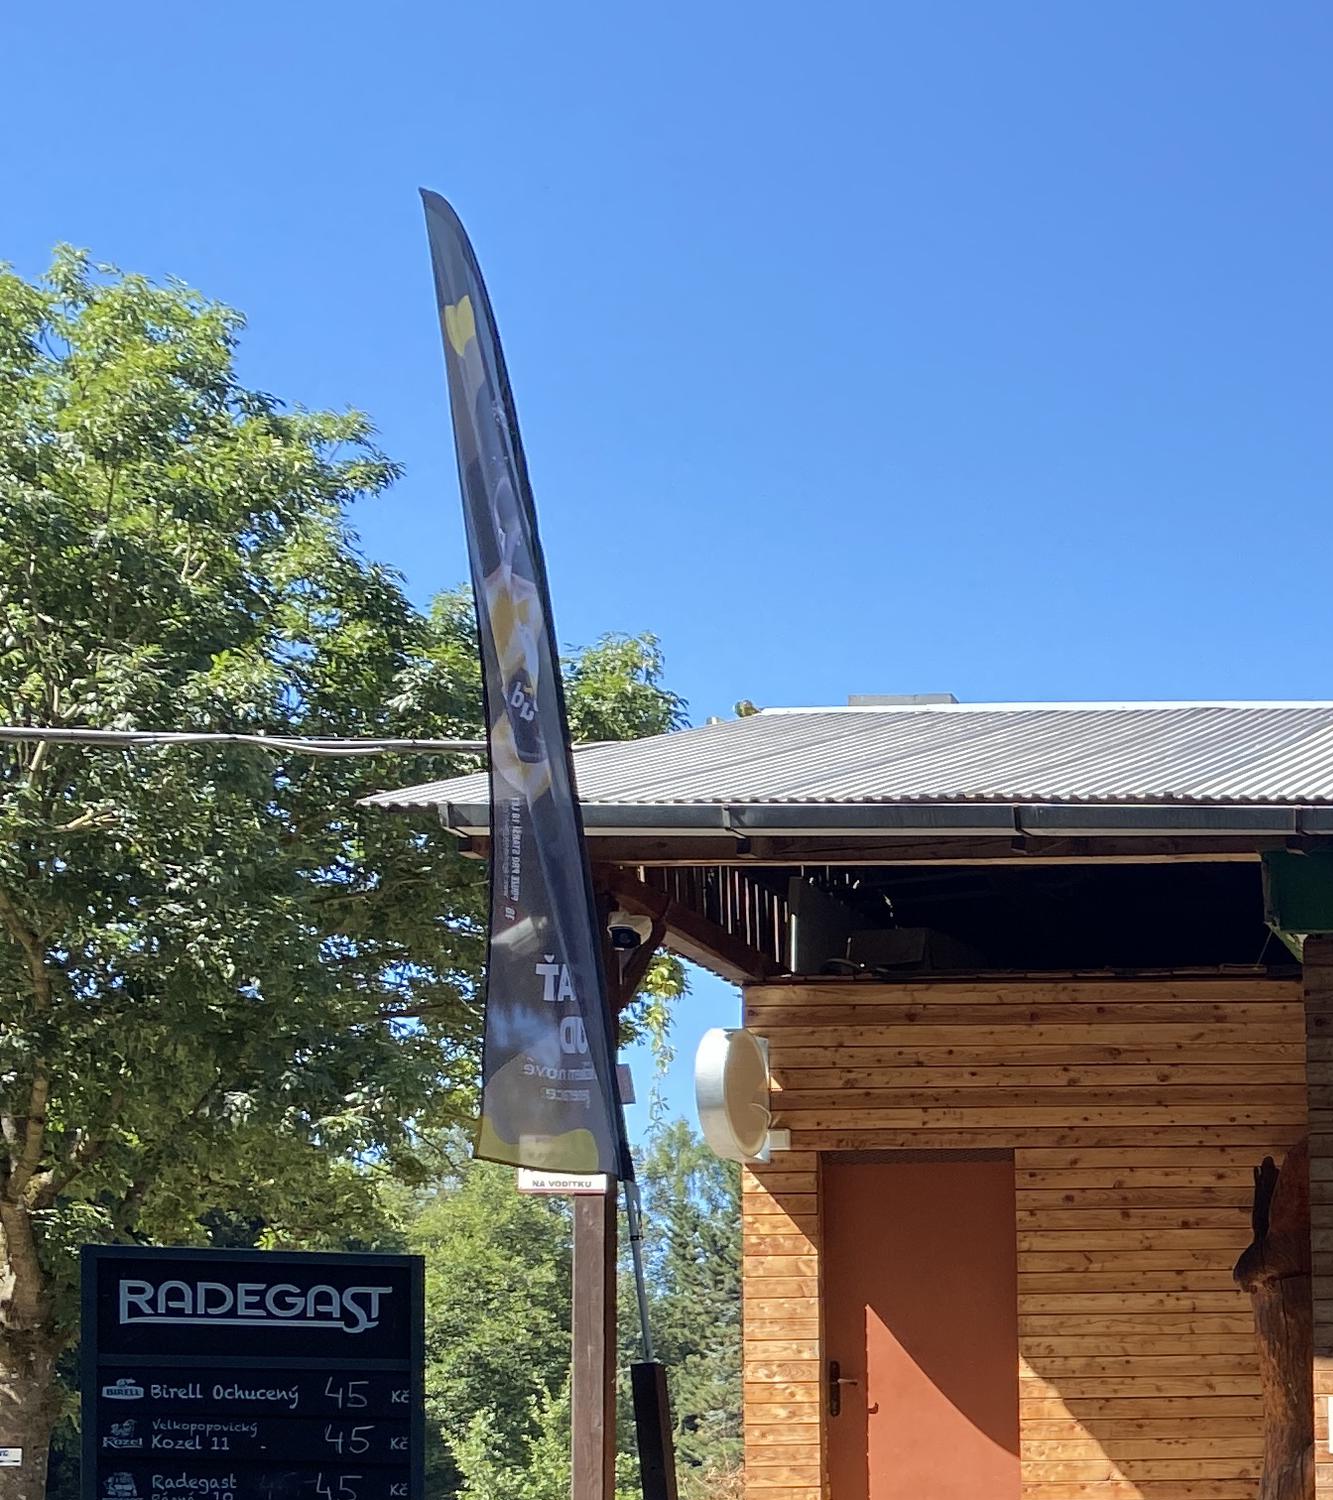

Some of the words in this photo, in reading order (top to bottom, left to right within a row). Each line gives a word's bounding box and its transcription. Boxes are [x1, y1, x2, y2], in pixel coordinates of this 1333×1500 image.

[532, 1179, 546, 1188] NA
[119, 1279, 393, 1334] RADEGAST
[150, 1383, 203, 1399] Birell
[212, 1384, 299, 1409] Ochucený
[324, 1377, 369, 1408] 45
[391, 1389, 410, 1403] Kč
[151, 1435, 203, 1450] Kozel
[210, 1436, 230, 1450] 11
[324, 1424, 375, 1454] 45
[390, 1437, 409, 1450] Kč
[152, 1472, 237, 1494] Radegast
[390, 1483, 409, 1496] Kč
